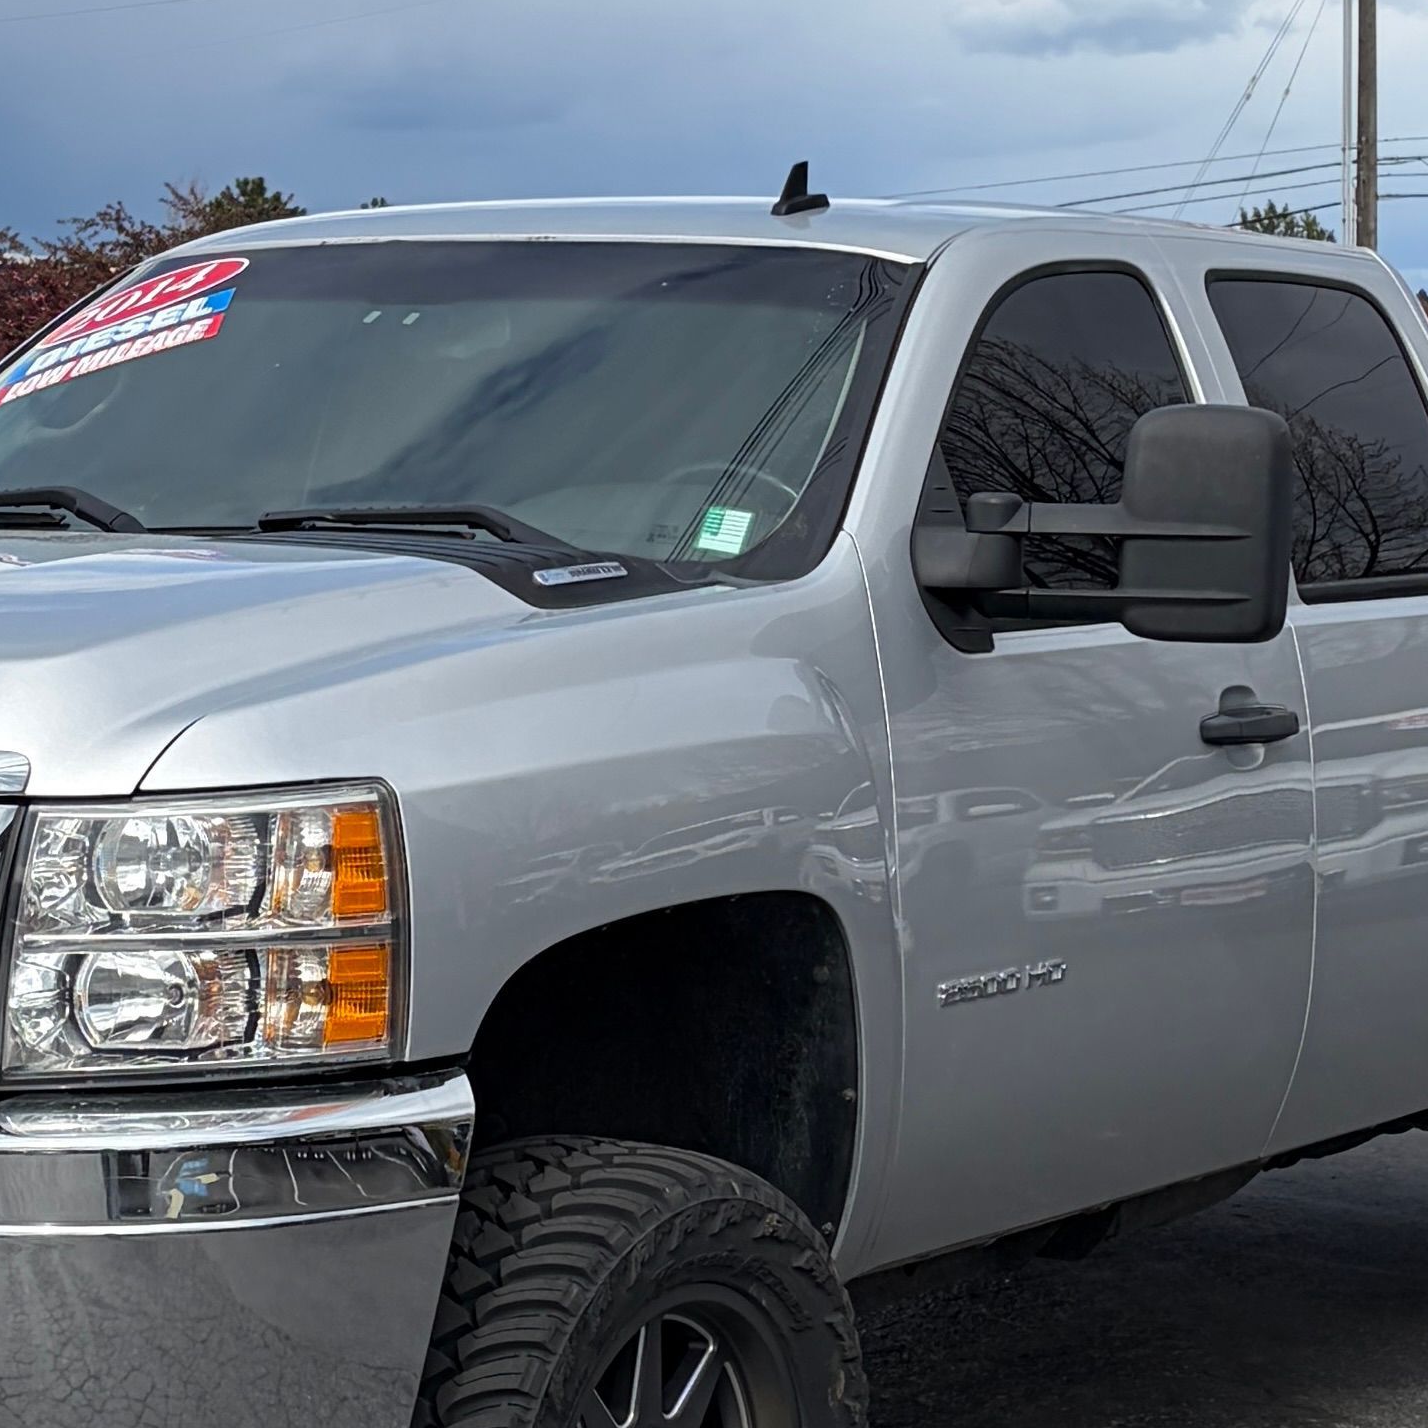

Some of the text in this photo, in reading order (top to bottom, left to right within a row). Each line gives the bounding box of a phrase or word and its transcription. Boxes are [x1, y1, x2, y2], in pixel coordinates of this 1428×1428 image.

[24, 296, 214, 376] DIESEL
[70, 263, 220, 332] 2014
[0, 317, 215, 404] LOW MILEAGE
